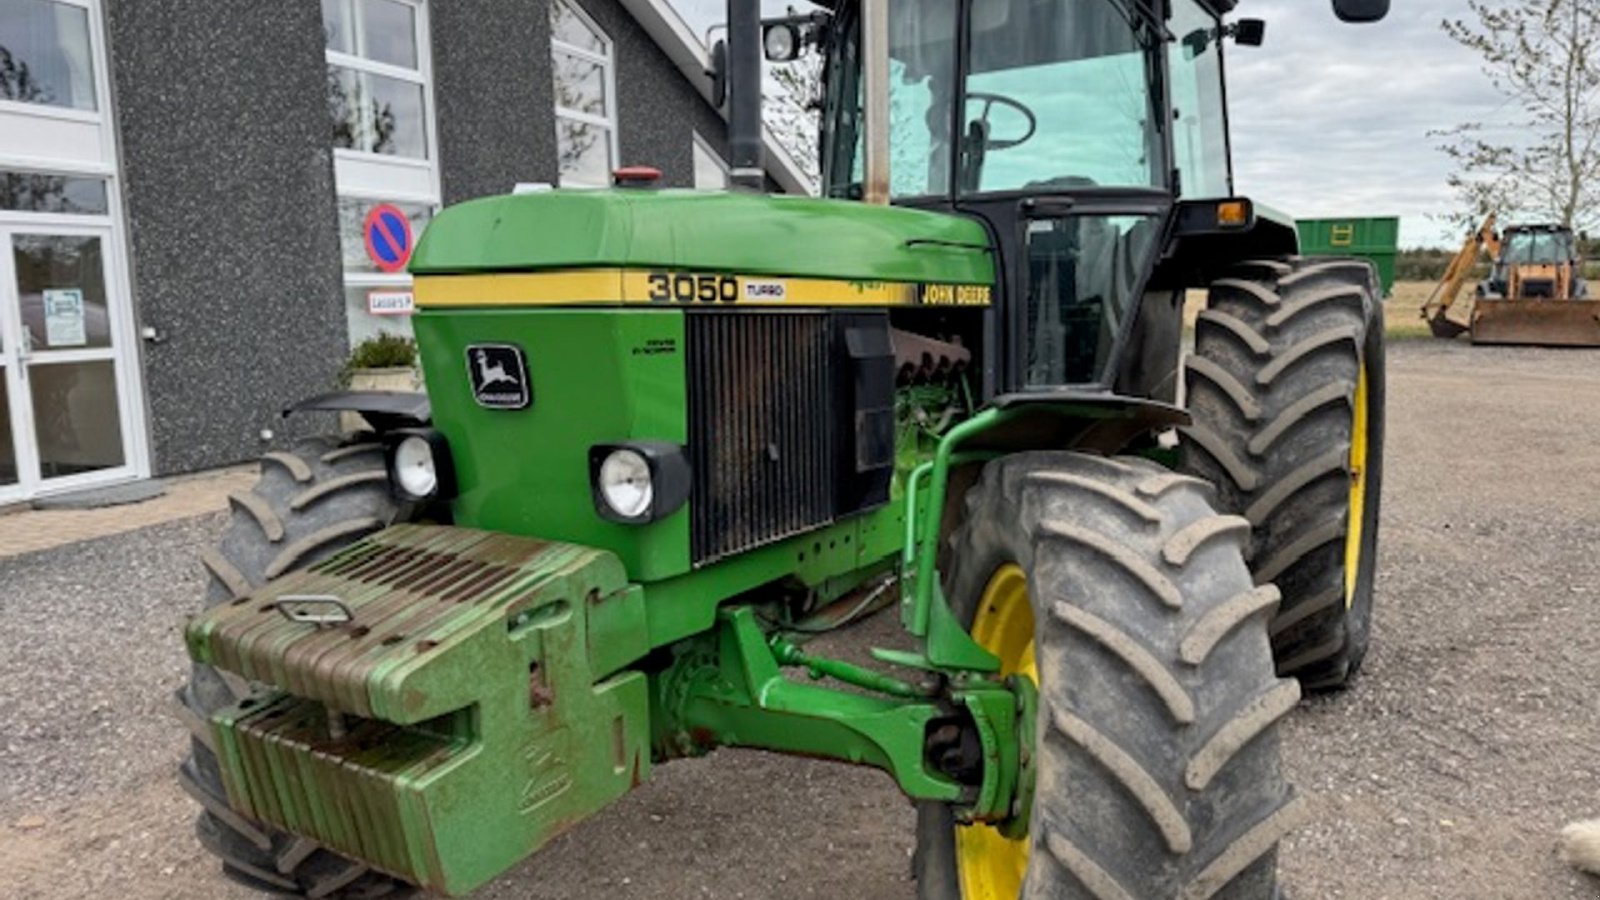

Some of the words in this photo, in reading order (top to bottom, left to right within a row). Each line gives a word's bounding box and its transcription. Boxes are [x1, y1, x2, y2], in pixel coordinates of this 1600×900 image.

[648, 274, 738, 301] 3050
[746, 284, 784, 297] TURBO
[922, 283, 954, 304] JOHN
[957, 284, 991, 304] DEERE
